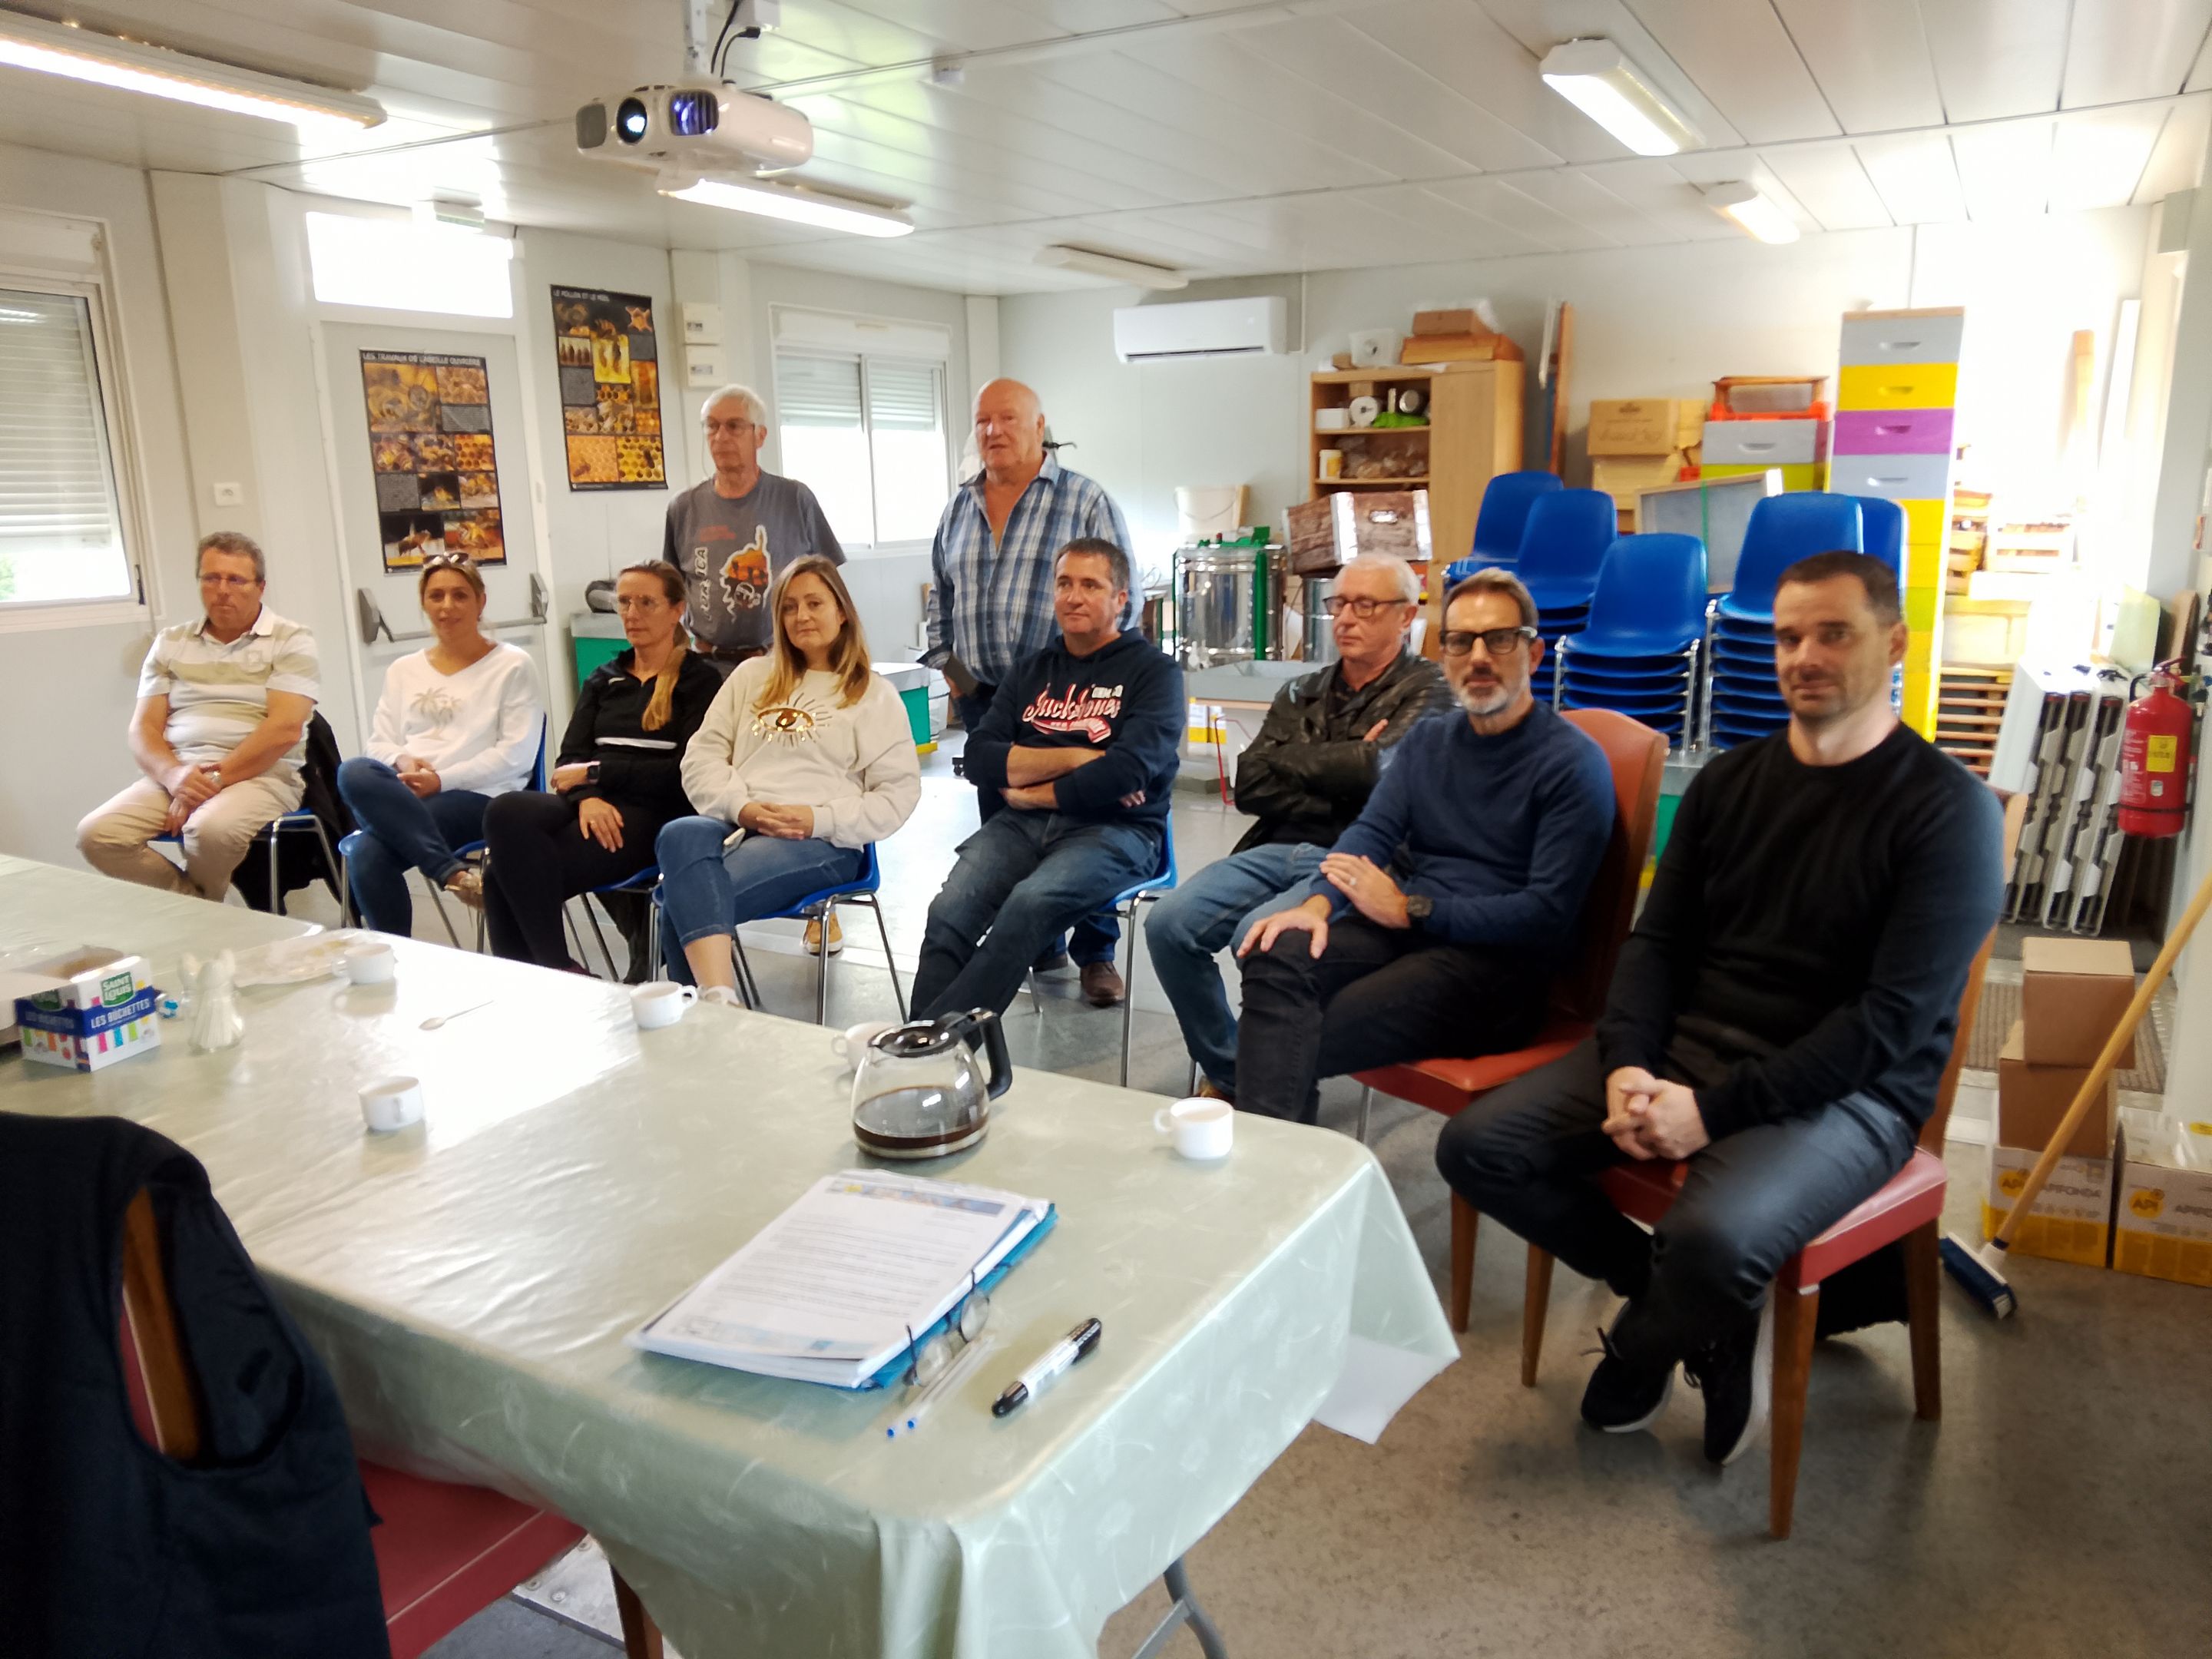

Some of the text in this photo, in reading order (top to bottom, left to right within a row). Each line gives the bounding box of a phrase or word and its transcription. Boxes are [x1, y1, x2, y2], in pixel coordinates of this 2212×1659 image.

[103, 975, 131, 988] SAINT
[104, 983, 132, 1001] LOUIS
[91, 1015, 107, 1028] LES
